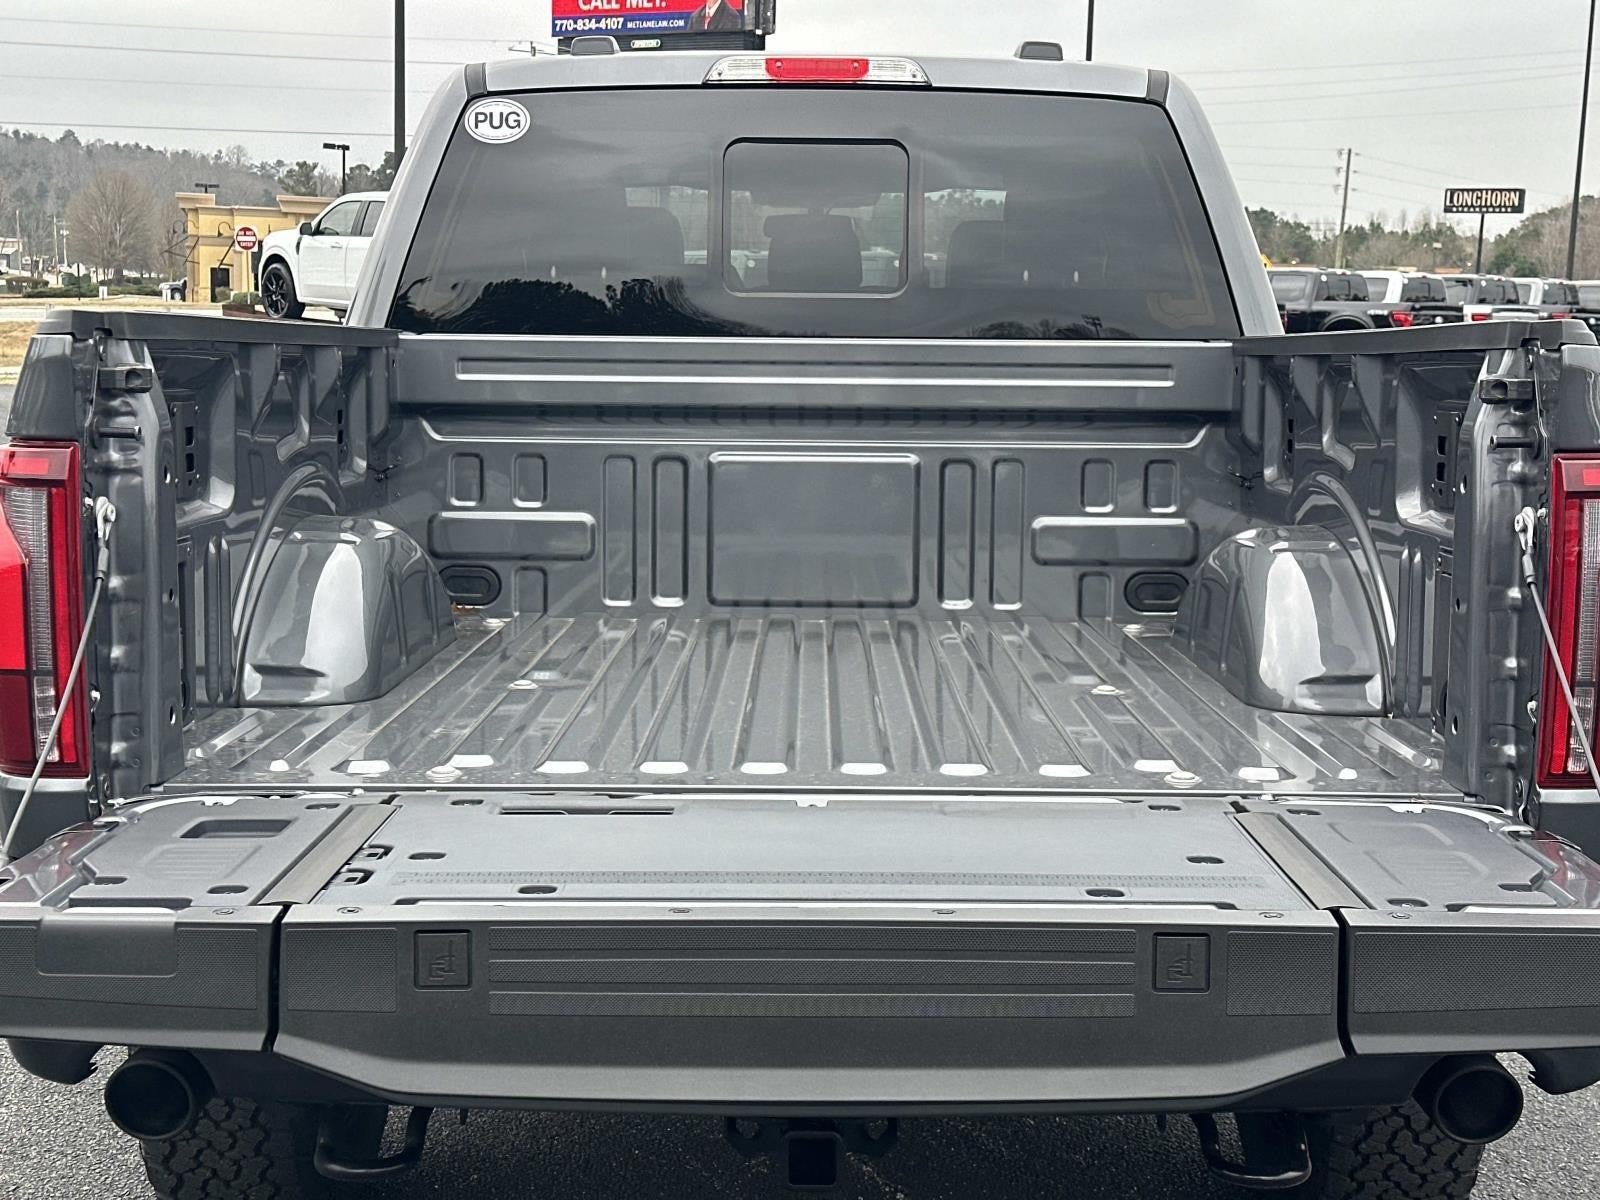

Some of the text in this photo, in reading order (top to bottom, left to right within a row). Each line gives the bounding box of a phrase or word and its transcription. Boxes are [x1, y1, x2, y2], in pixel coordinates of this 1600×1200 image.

[578, 0, 620, 10] CALL
[554, 17, 685, 31] 770-834-4107 METLANELAW.COM
[474, 111, 521, 130] PUG
[1445, 190, 1519, 206] LONGHORN
